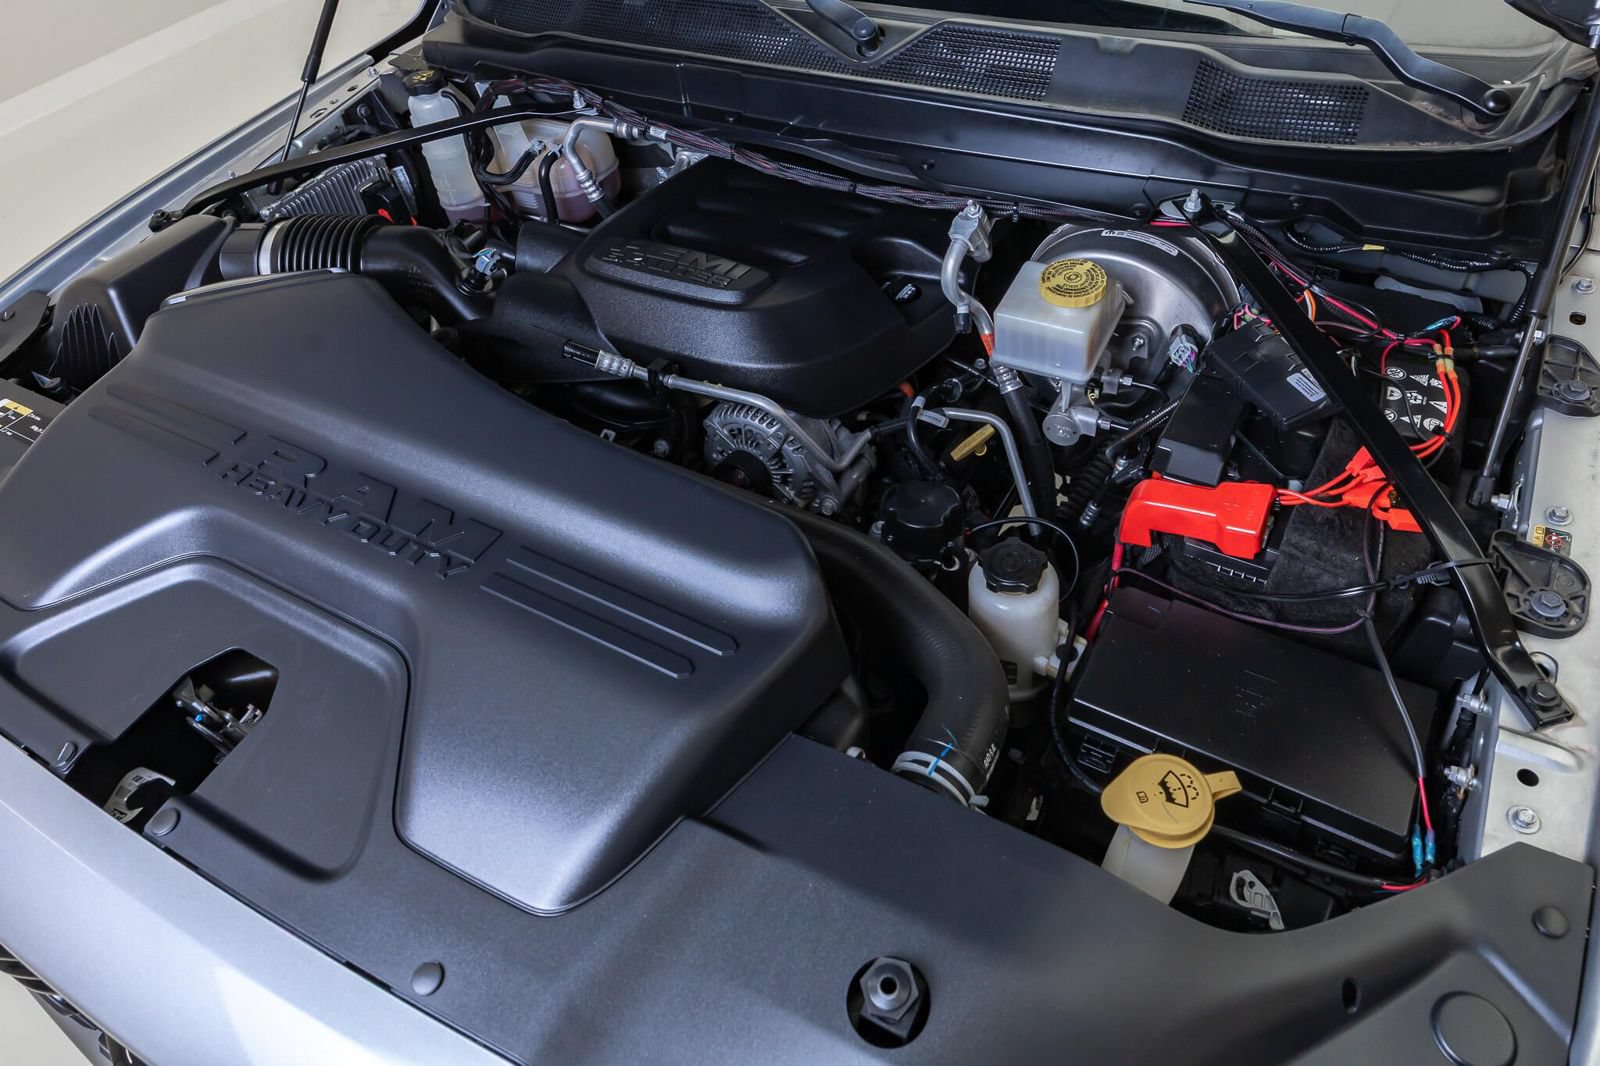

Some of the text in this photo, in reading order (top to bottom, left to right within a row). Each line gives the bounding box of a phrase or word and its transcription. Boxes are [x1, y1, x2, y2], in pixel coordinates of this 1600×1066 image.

[222, 462, 475, 579] HEAVY DUTY
[256, 435, 504, 564] RAM
